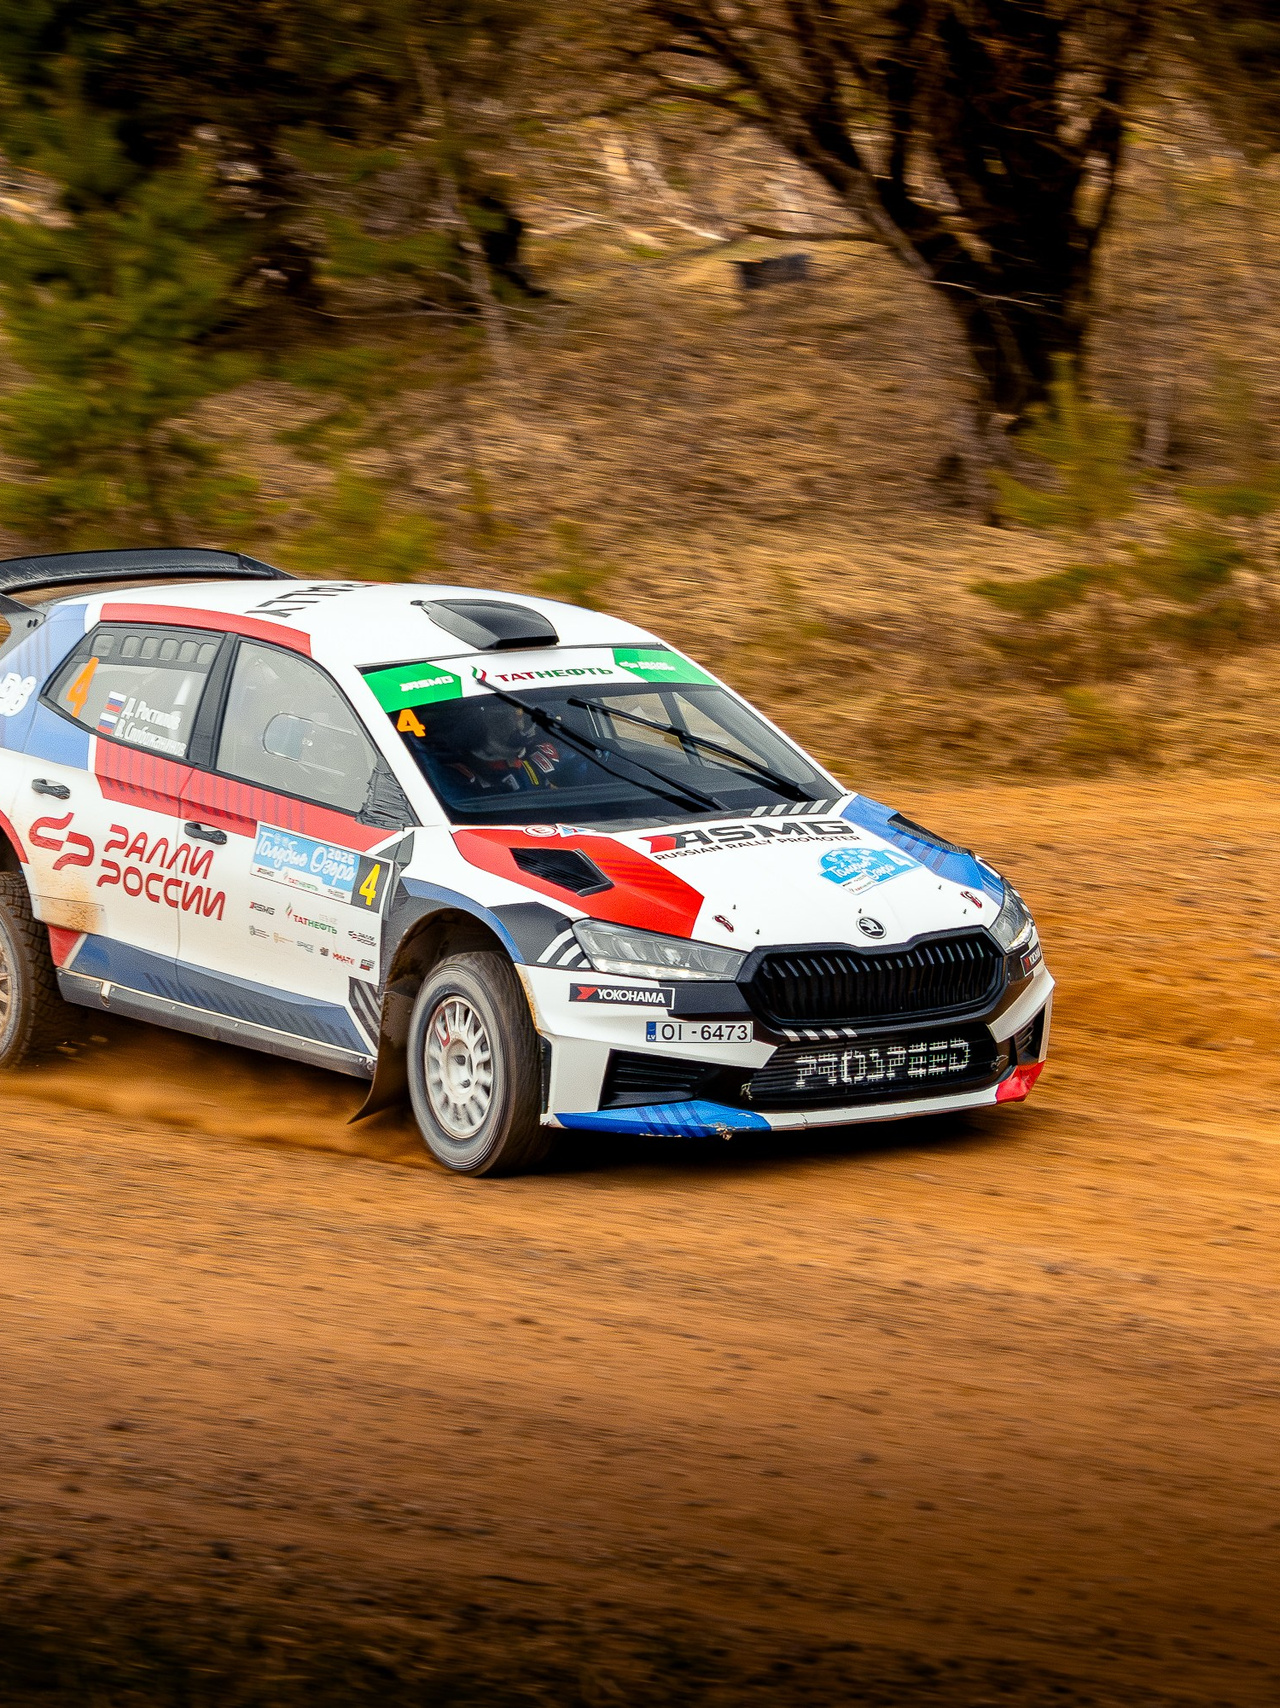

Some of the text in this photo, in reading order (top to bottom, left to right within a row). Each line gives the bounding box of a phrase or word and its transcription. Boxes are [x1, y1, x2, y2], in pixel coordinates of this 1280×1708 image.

[66, 656, 100, 718] 4
[495, 667, 613, 683] ТАТНЕФТЬ
[396, 708, 426, 738] 4
[104, 823, 214, 880] РАЛЛИ
[639, 820, 855, 852] ASMG
[653, 835, 862, 861] RUSSIAN RALLY PROMOTER
[96, 858, 226, 921] РОССИИ
[358, 863, 381, 906] 4
[293, 914, 338, 934] ТАТНЕФТЬ
[597, 988, 666, 1004] YOKOHAMA
